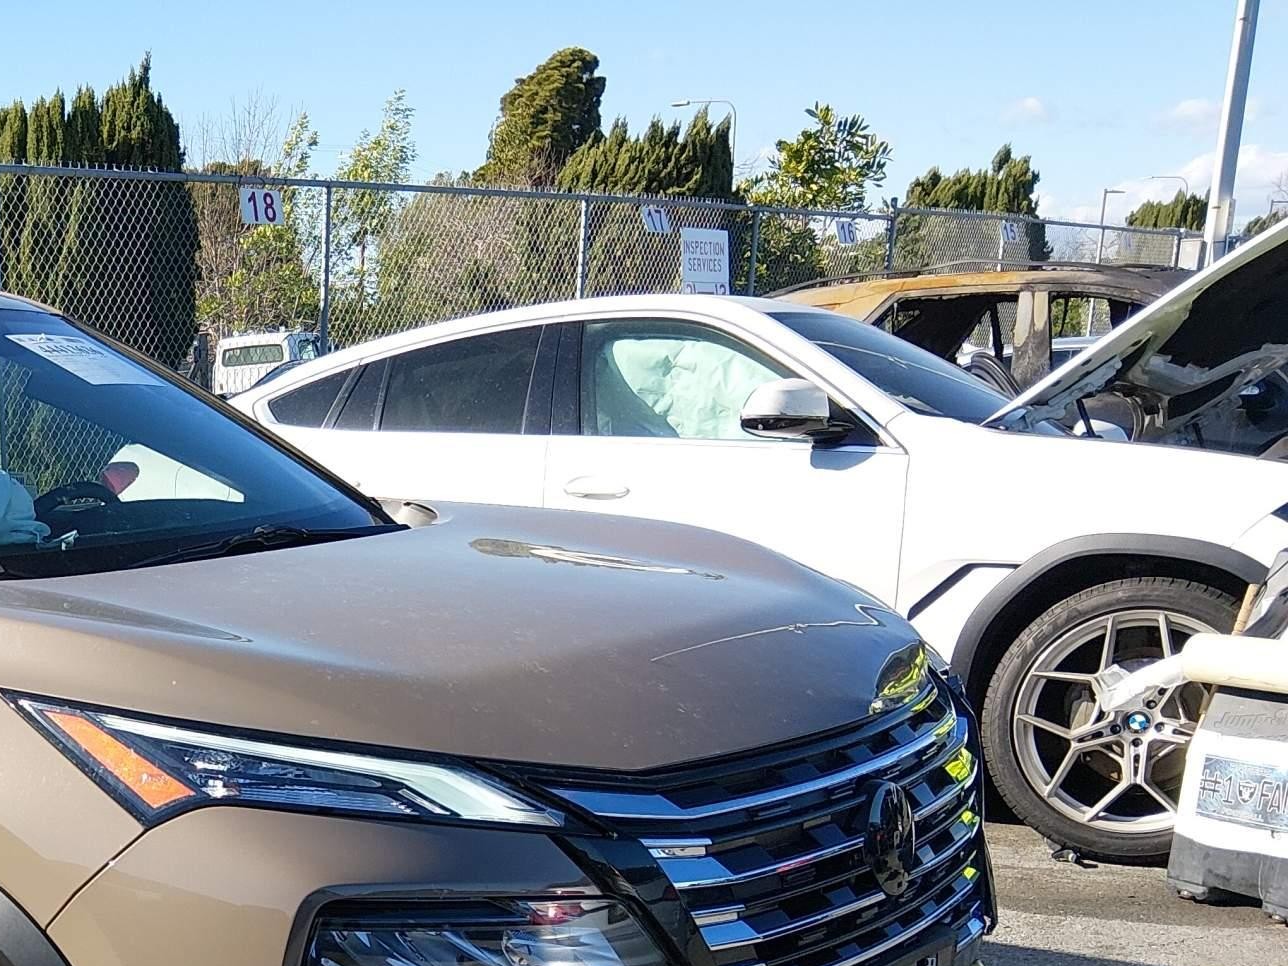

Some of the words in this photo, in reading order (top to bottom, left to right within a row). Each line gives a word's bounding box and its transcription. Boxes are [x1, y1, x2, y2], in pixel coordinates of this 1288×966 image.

[247, 191, 277, 223] 18
[647, 208, 665, 231] 17
[840, 222, 855, 243] 16
[1003, 223, 1016, 241] 15
[683, 240, 725, 256] INSPECTION
[688, 257, 722, 273] SERVICES
